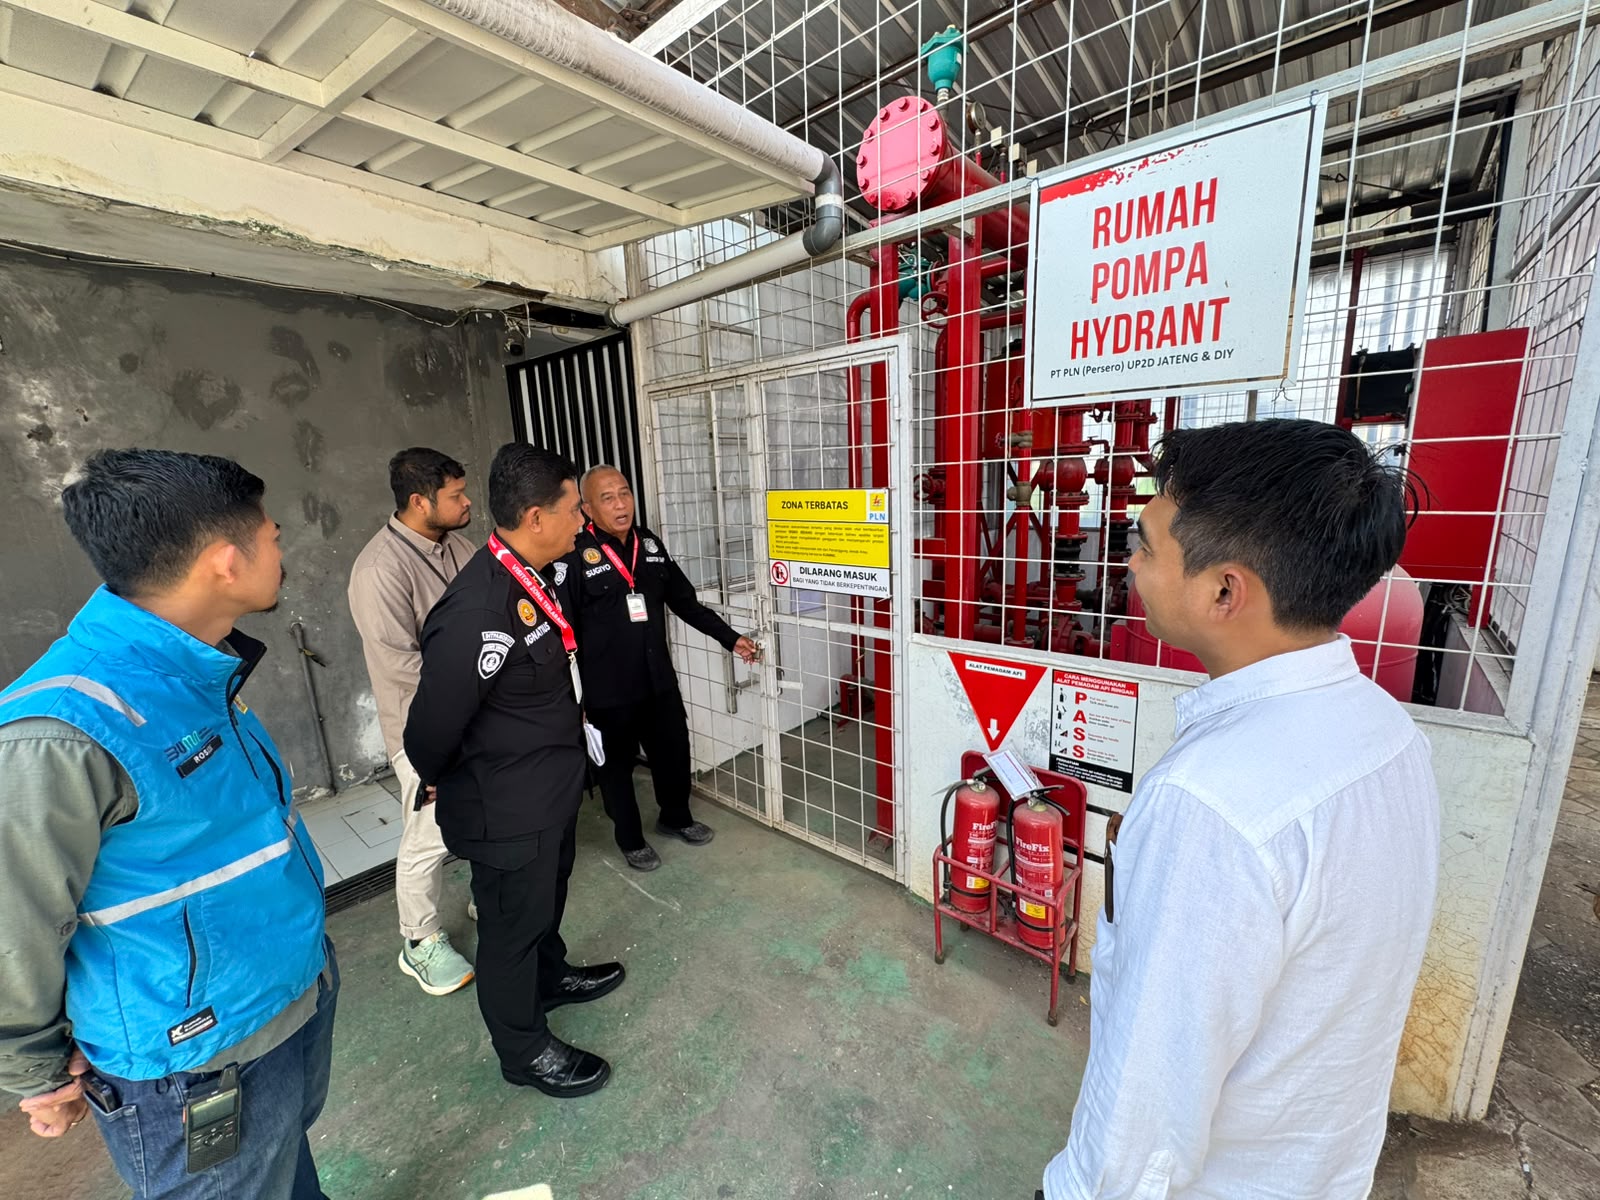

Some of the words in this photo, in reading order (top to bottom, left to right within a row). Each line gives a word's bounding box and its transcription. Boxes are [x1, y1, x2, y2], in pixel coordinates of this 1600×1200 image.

[1092, 177, 1218, 249] RUMAH
[1091, 240, 1208, 304] POMPA
[1070, 296, 1230, 360] HYDRANT
[1050, 369, 1061, 378] PT
[1063, 367, 1080, 377] PLN
[1082, 361, 1125, 376] (Persero)
[1127, 358, 1155, 370] UP2D
[1157, 352, 1198, 366] JATENG
[1201, 351, 1211, 361] &
[1214, 349, 1234, 360] DIY
[781, 501, 803, 510] ZONA
[805, 501, 849, 510] TERBATAS
[585, 563, 612, 578] SUGIYO
[799, 566, 842, 578] DILARANG
[844, 571, 877, 581] MASUK
[511, 563, 532, 590] VISITOR
[529, 583, 544, 602] ZONA
[820, 579, 836, 587] TIDAK
[836, 580, 888, 592] BERKEPENTINGAN
[984, 665, 1011, 674] PEMADAM
[1071, 680, 1100, 689] PEMADAM
[1080, 676, 1126, 689] MENGGUNAKAN
[1075, 691, 1088, 705] P
[1072, 709, 1087, 724] A
[1073, 727, 1085, 742] S
[1072, 744, 1085, 759] S
